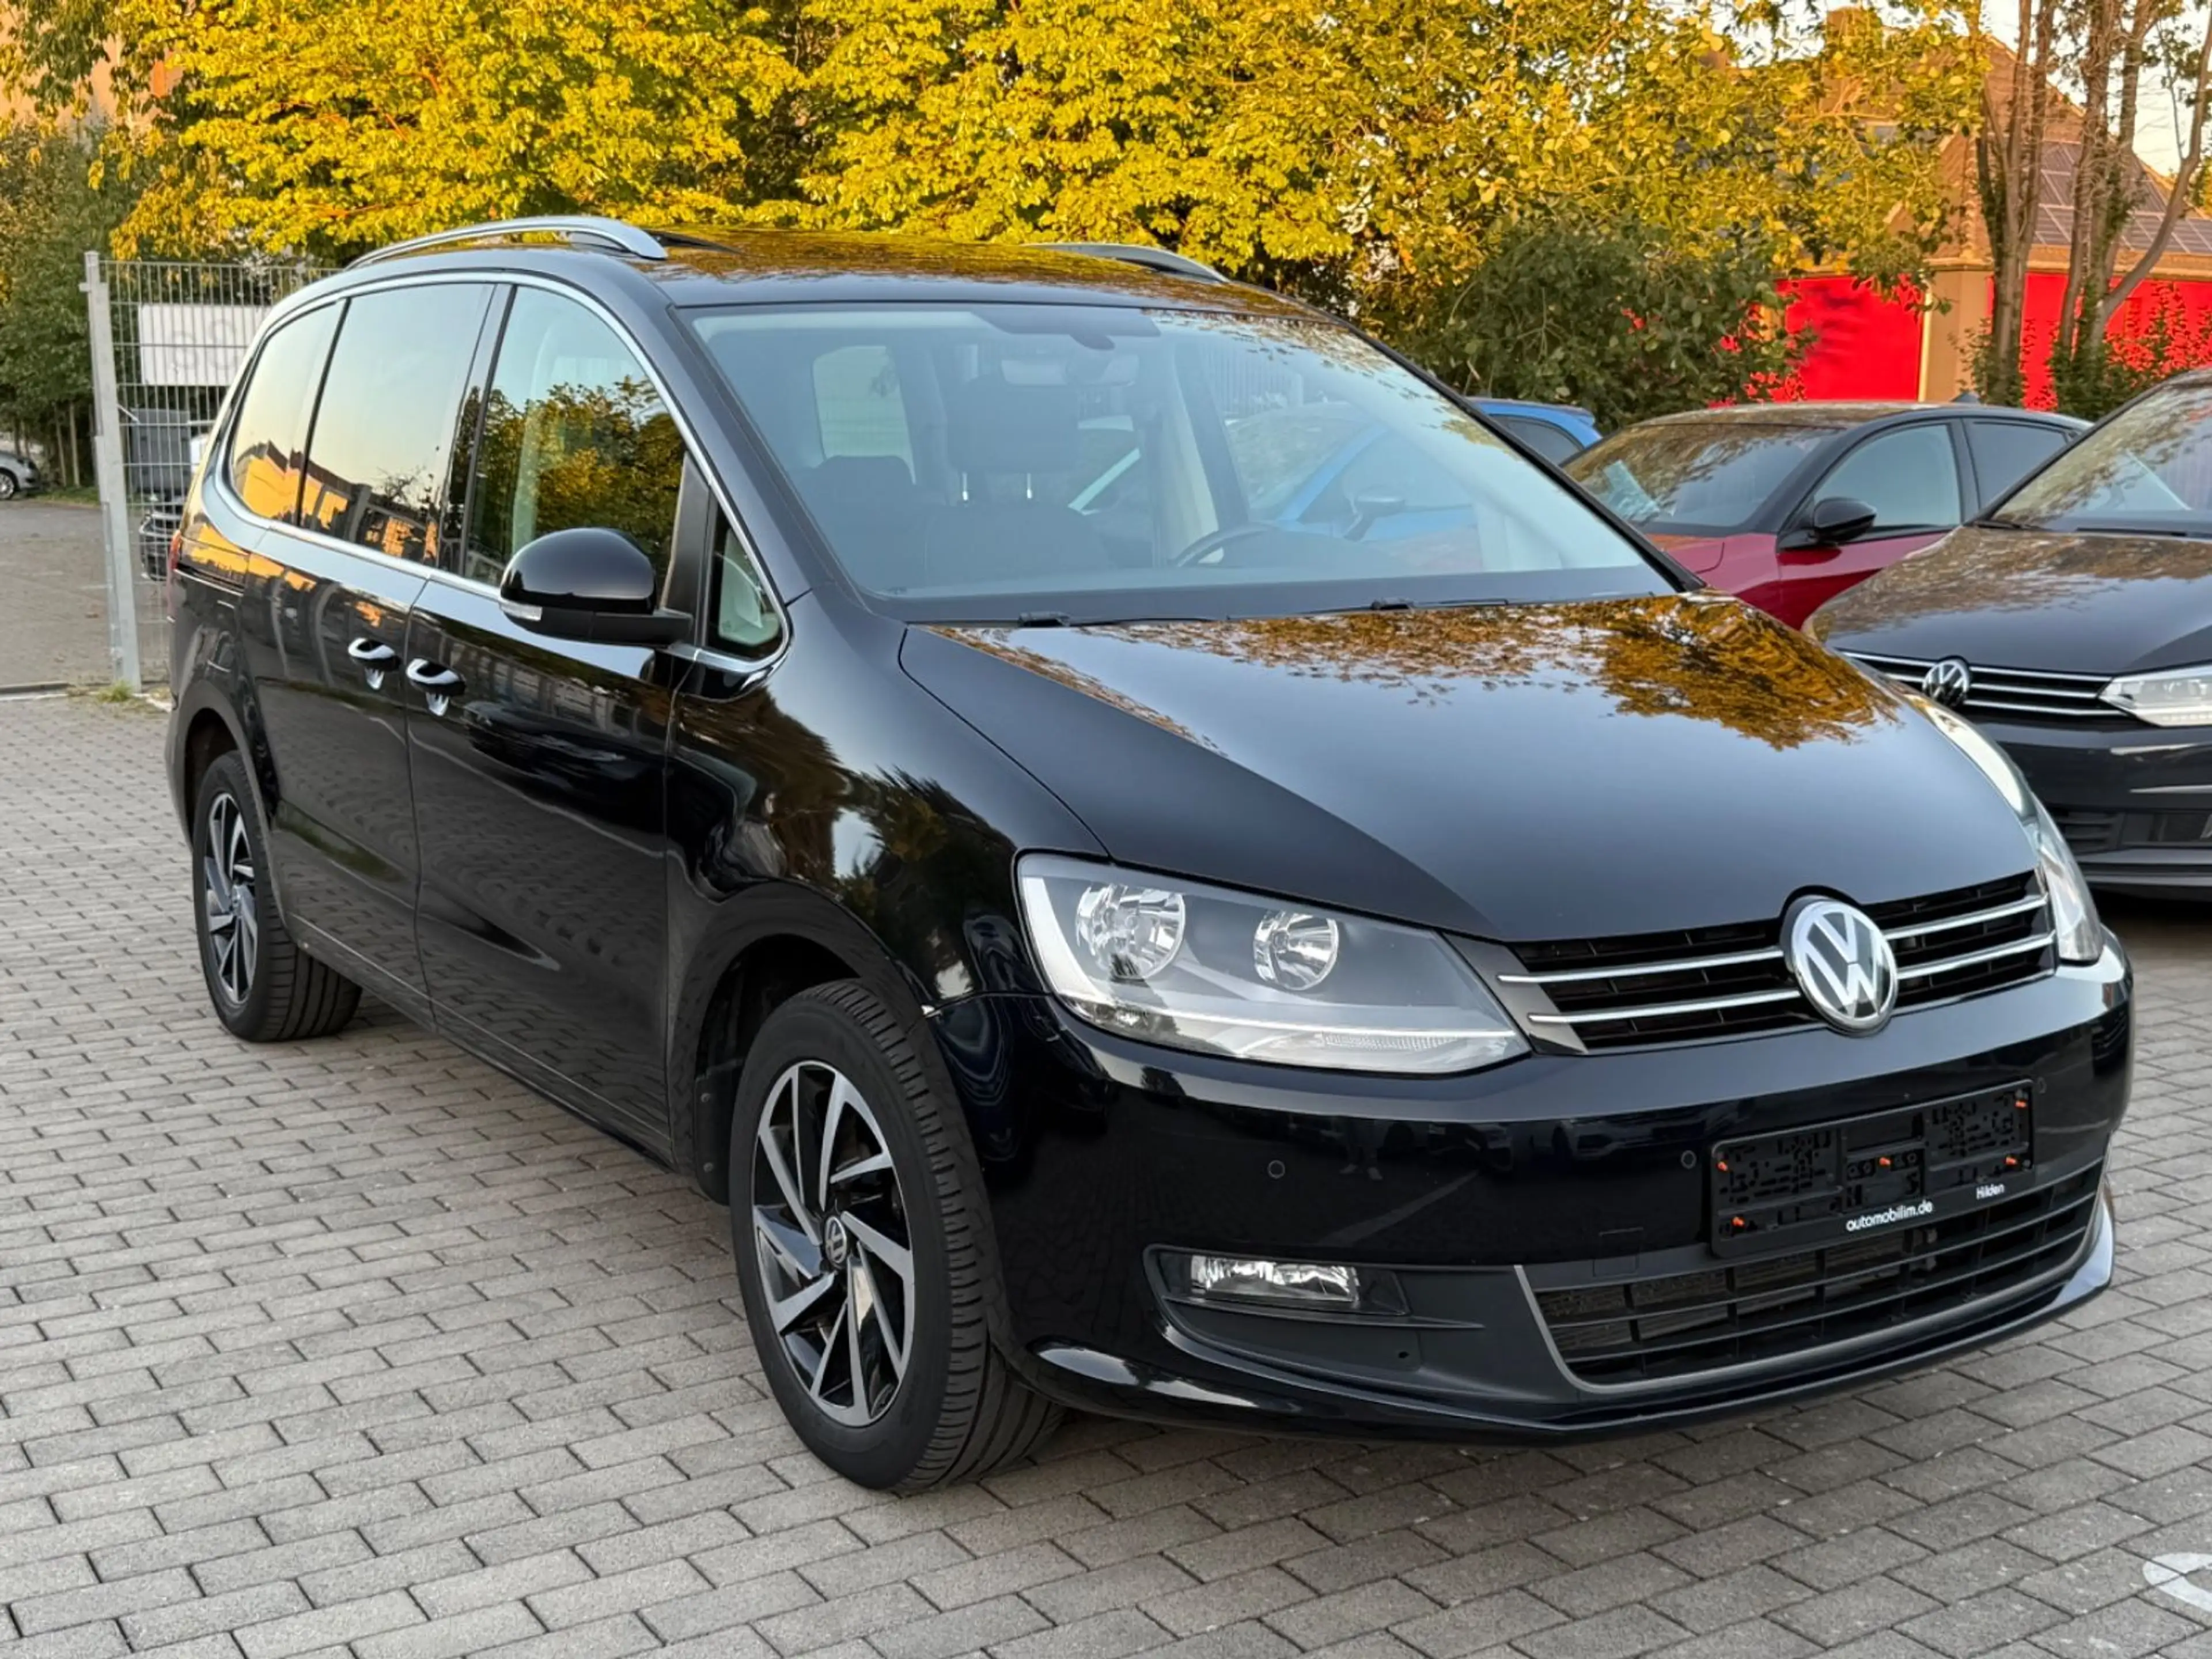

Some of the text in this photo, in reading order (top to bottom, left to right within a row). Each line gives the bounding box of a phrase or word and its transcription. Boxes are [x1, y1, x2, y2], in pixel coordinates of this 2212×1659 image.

[1922, 660, 1969, 708] VW
[1793, 902, 1896, 1030] VW
[1976, 1183, 2005, 1200] Hilden
[1846, 1199, 1934, 1232] automobilim.de
